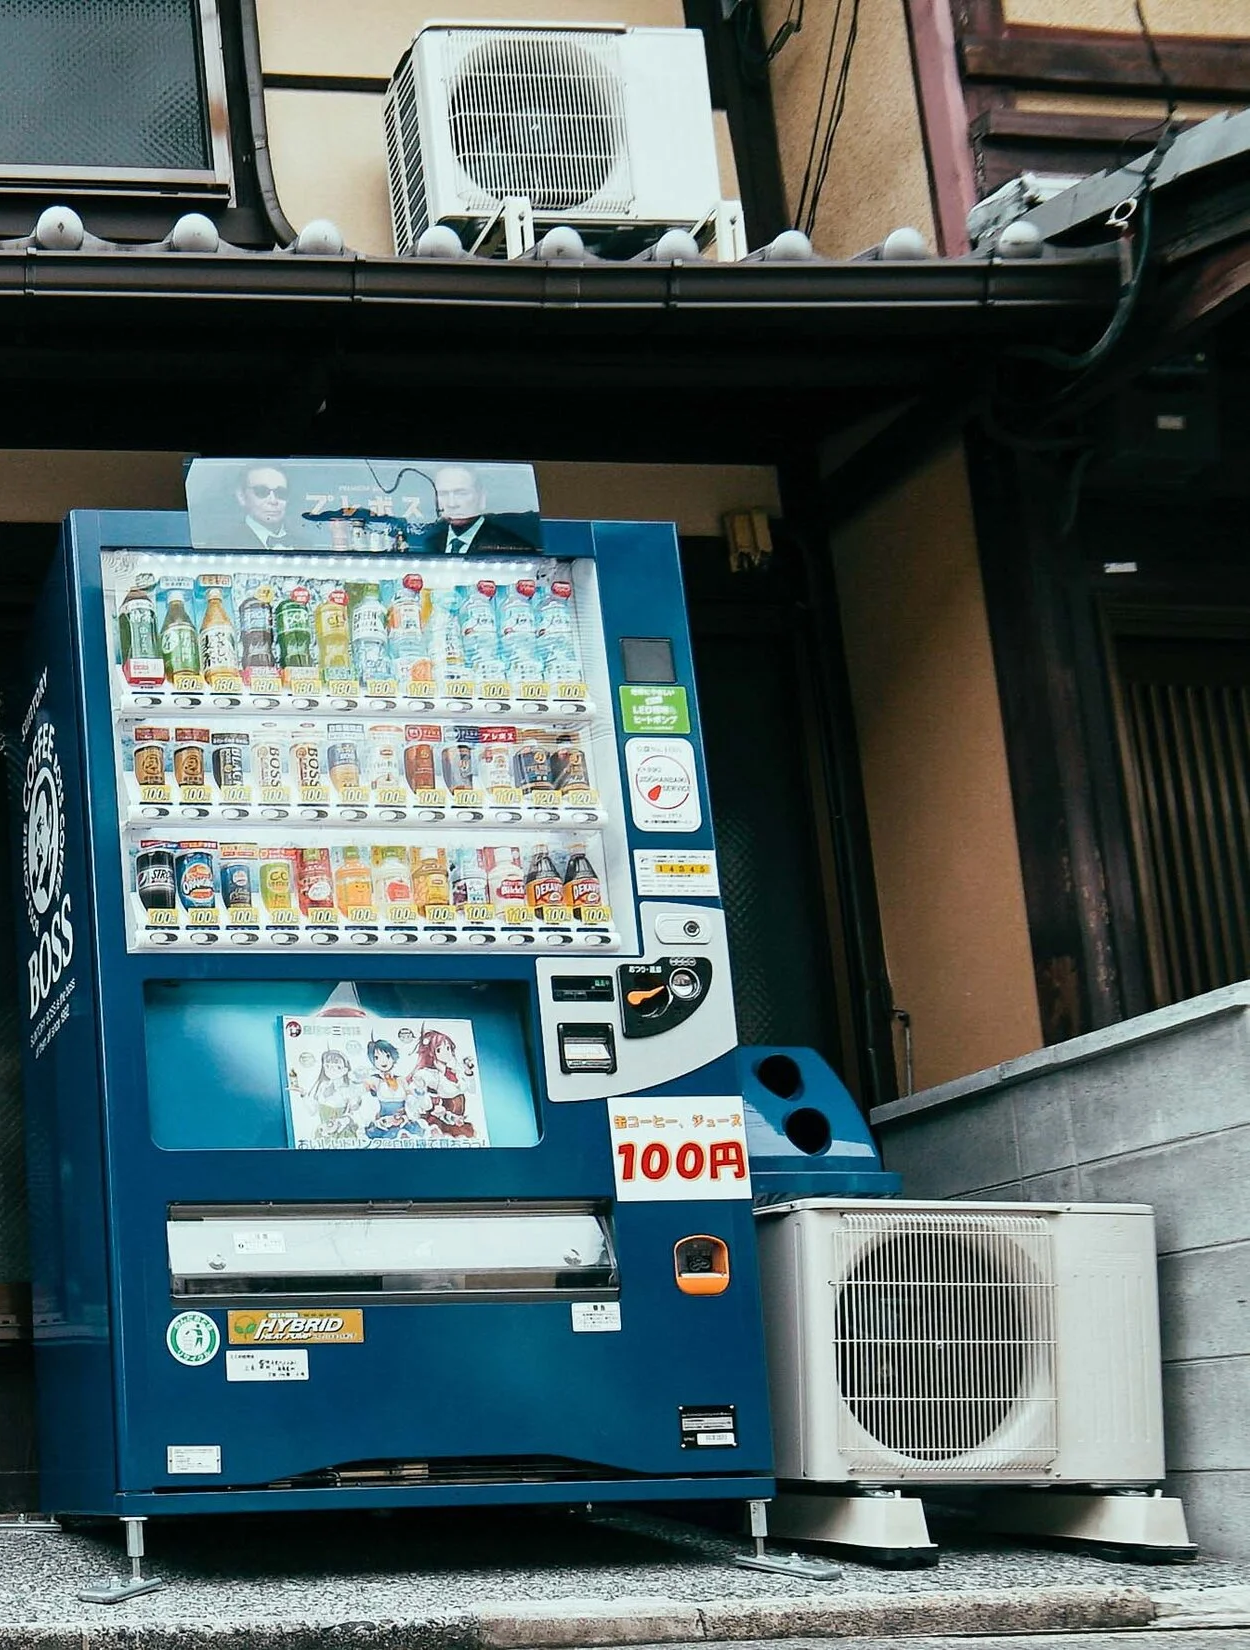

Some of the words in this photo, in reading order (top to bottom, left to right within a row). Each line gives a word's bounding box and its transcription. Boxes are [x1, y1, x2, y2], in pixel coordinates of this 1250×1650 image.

[23, 722, 55, 813] COFFEE
[28, 893, 73, 1020] BOSS
[617, 1141, 747, 1181] 100円
[254, 1317, 344, 1340] HYBRID
